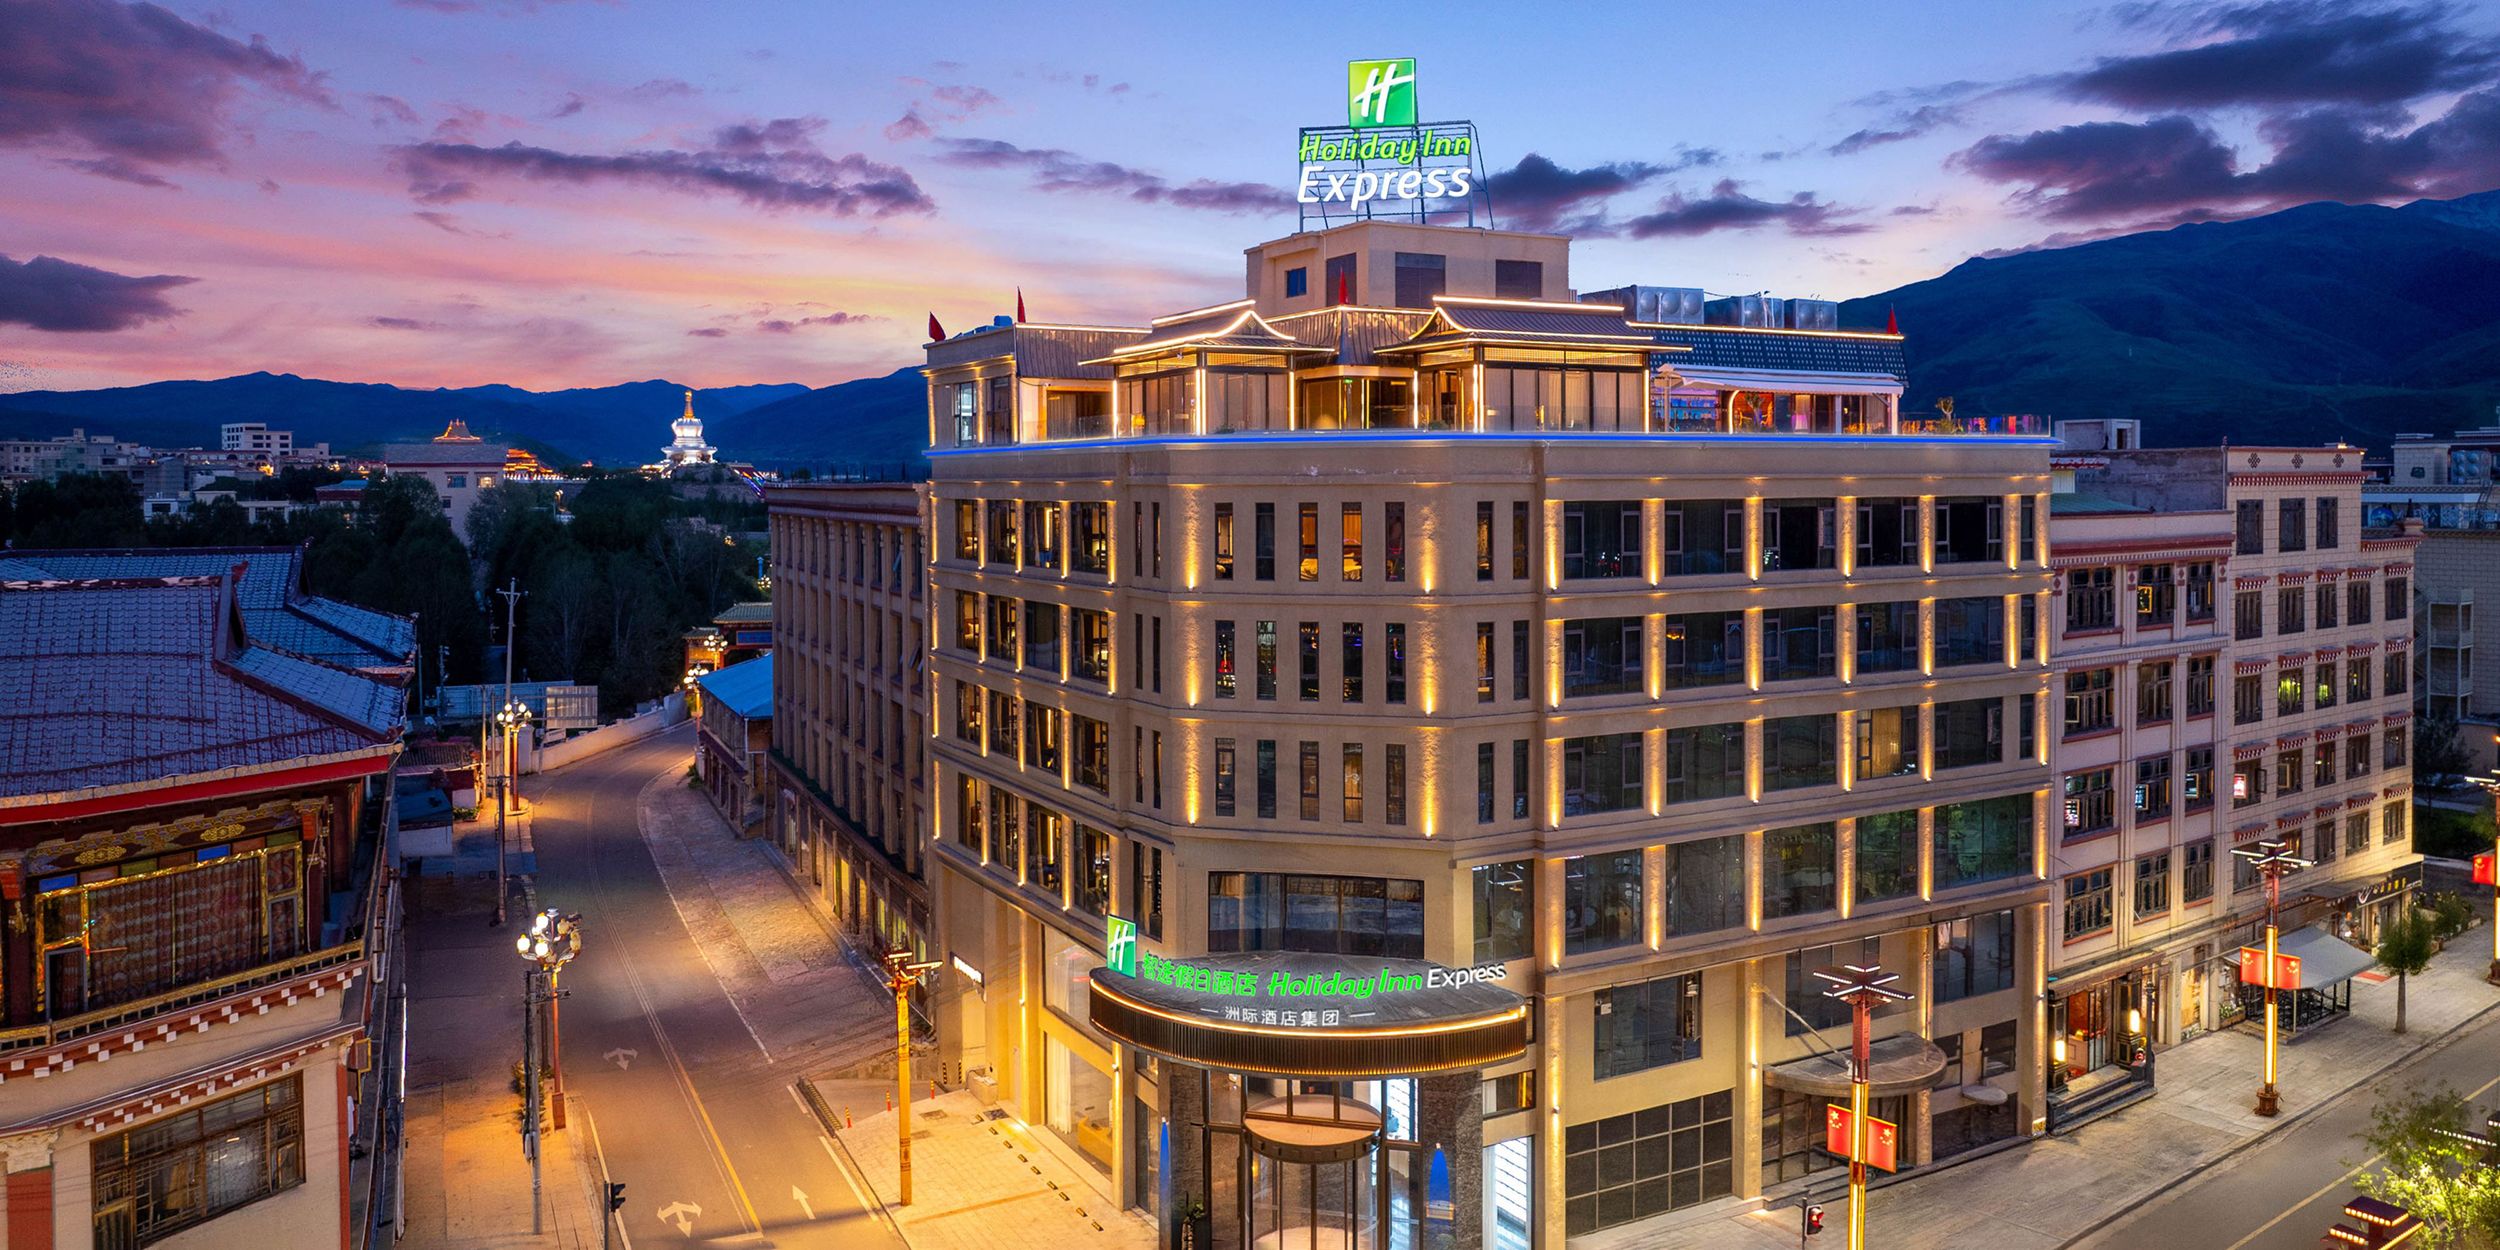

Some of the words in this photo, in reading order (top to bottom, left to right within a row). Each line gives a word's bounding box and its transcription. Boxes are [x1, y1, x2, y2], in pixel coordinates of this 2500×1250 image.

[1353, 64, 1414, 123] H
[1299, 133, 1418, 165] Holiday
[1423, 130, 1472, 157] Inn
[1297, 165, 1472, 211] Express
[1109, 923, 1136, 971] H
[1143, 951, 1258, 997] 智选假日酒店
[1267, 970, 1375, 999] Holiday
[1377, 967, 1423, 993] Inn
[1427, 964, 1507, 990] Express
[1224, 1006, 1340, 1027] 洲际酒店集团
